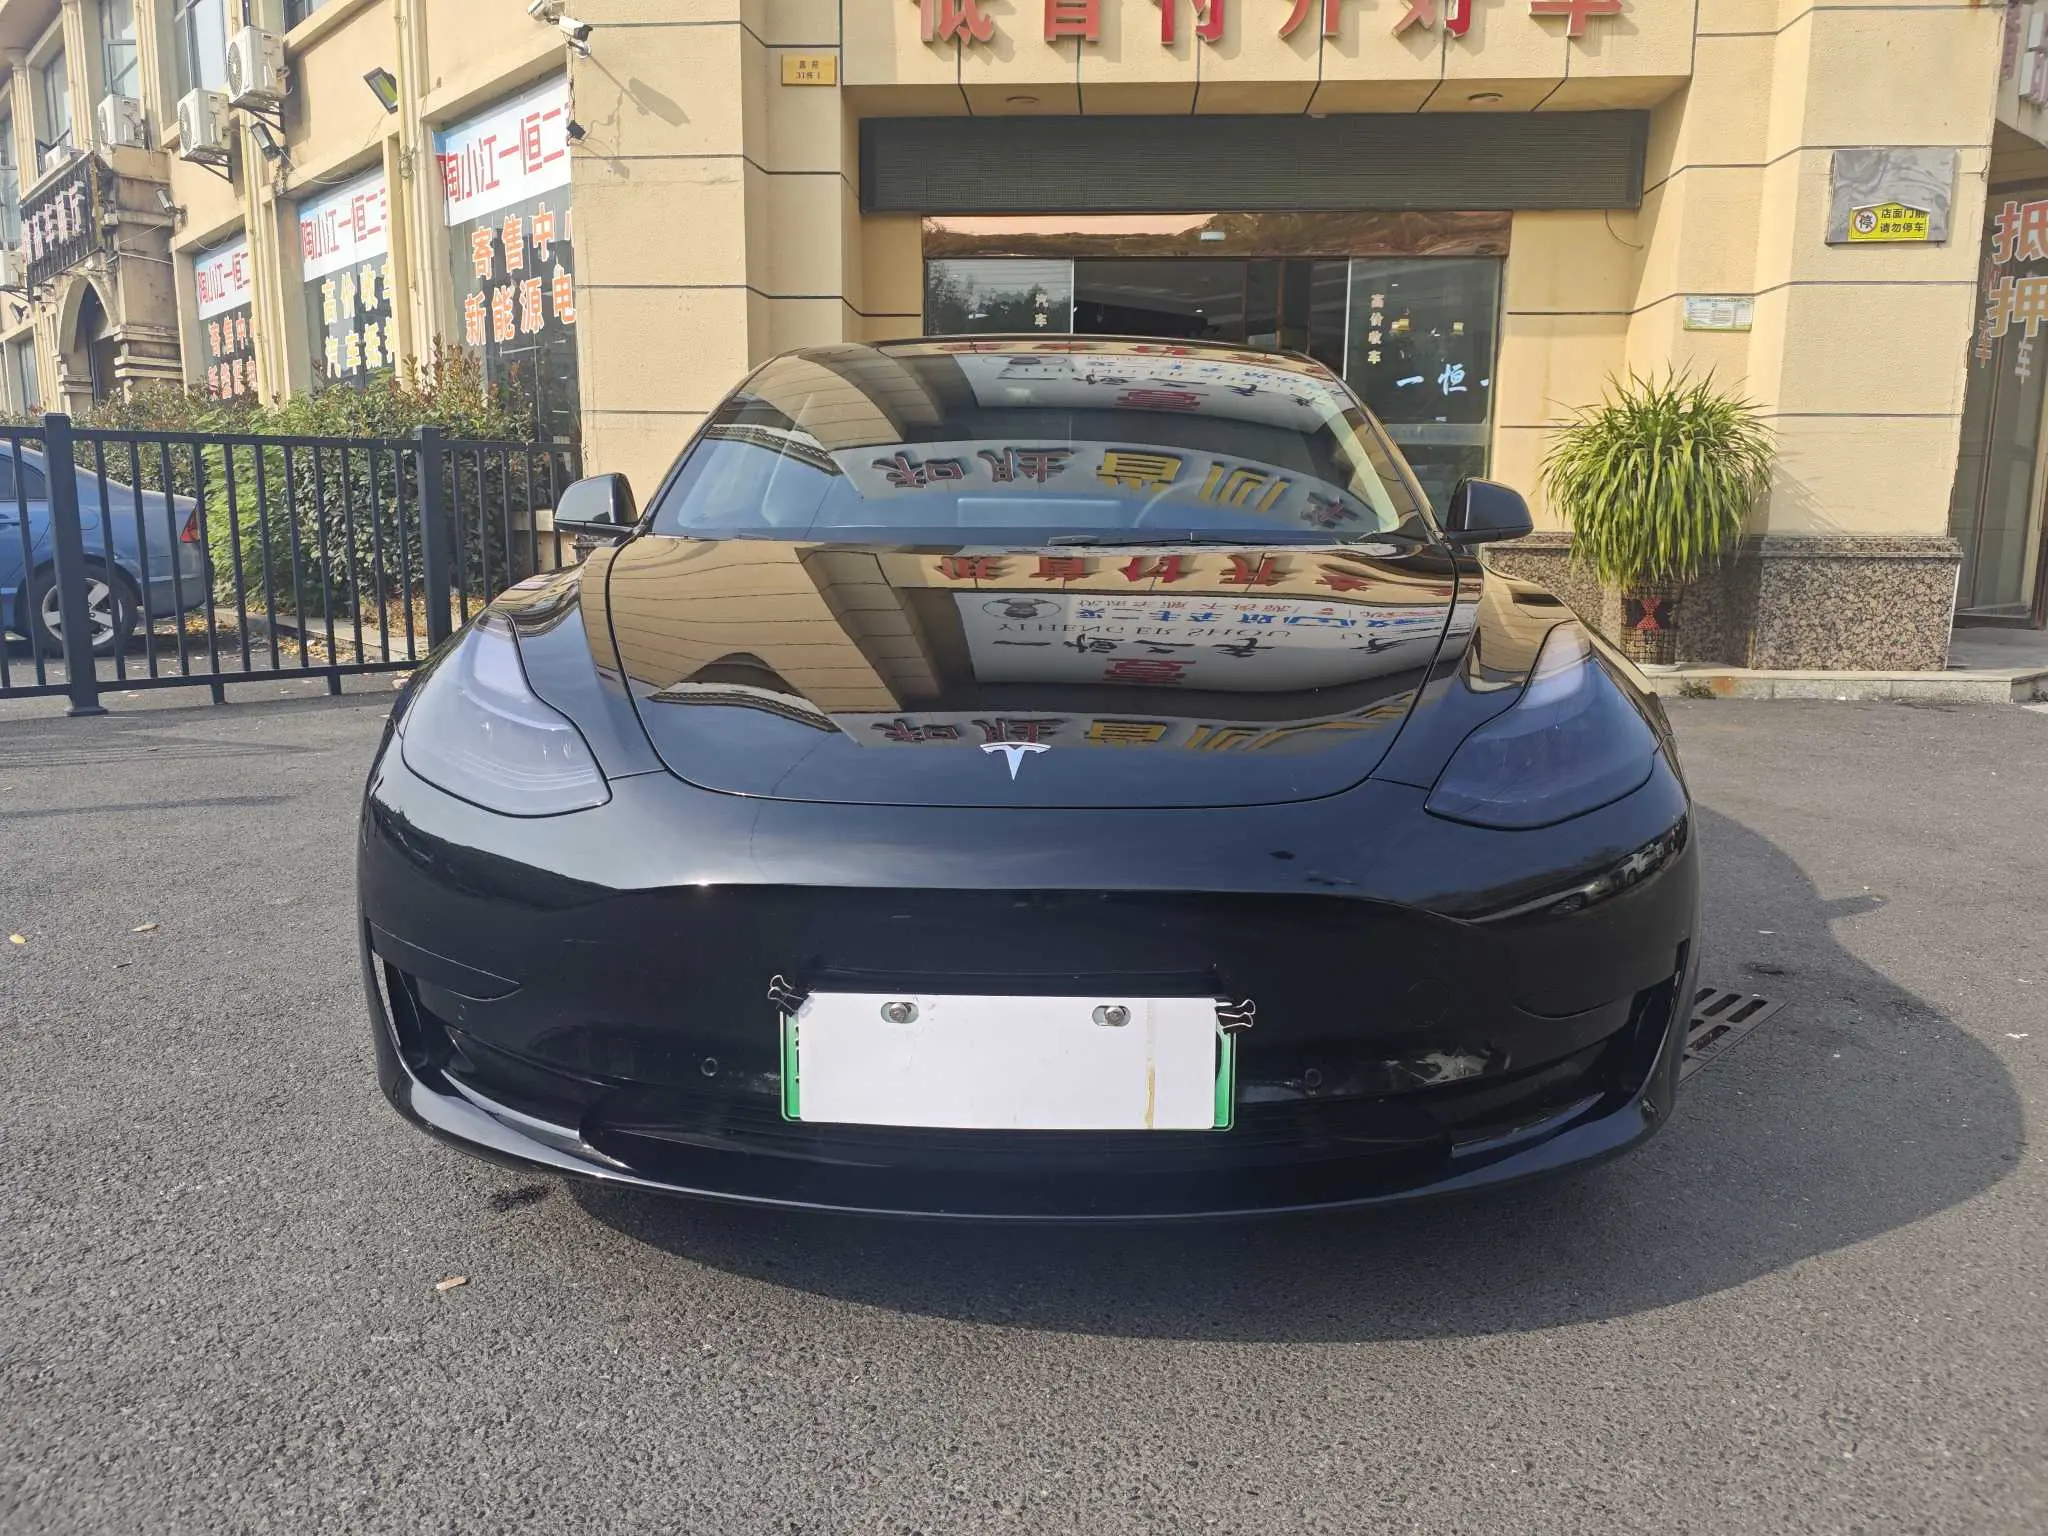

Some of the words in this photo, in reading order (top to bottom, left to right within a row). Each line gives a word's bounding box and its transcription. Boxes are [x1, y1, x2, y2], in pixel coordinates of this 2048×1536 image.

[436, 102, 571, 201] 陶小江一恒二
[300, 188, 386, 263] 陶小江一恒二
[1880, 223, 1925, 233] 请勿停车
[208, 312, 254, 357] 寄售中
[1368, 293, 1385, 364] 高价收车
[1396, 363, 1489, 396] 一恒
